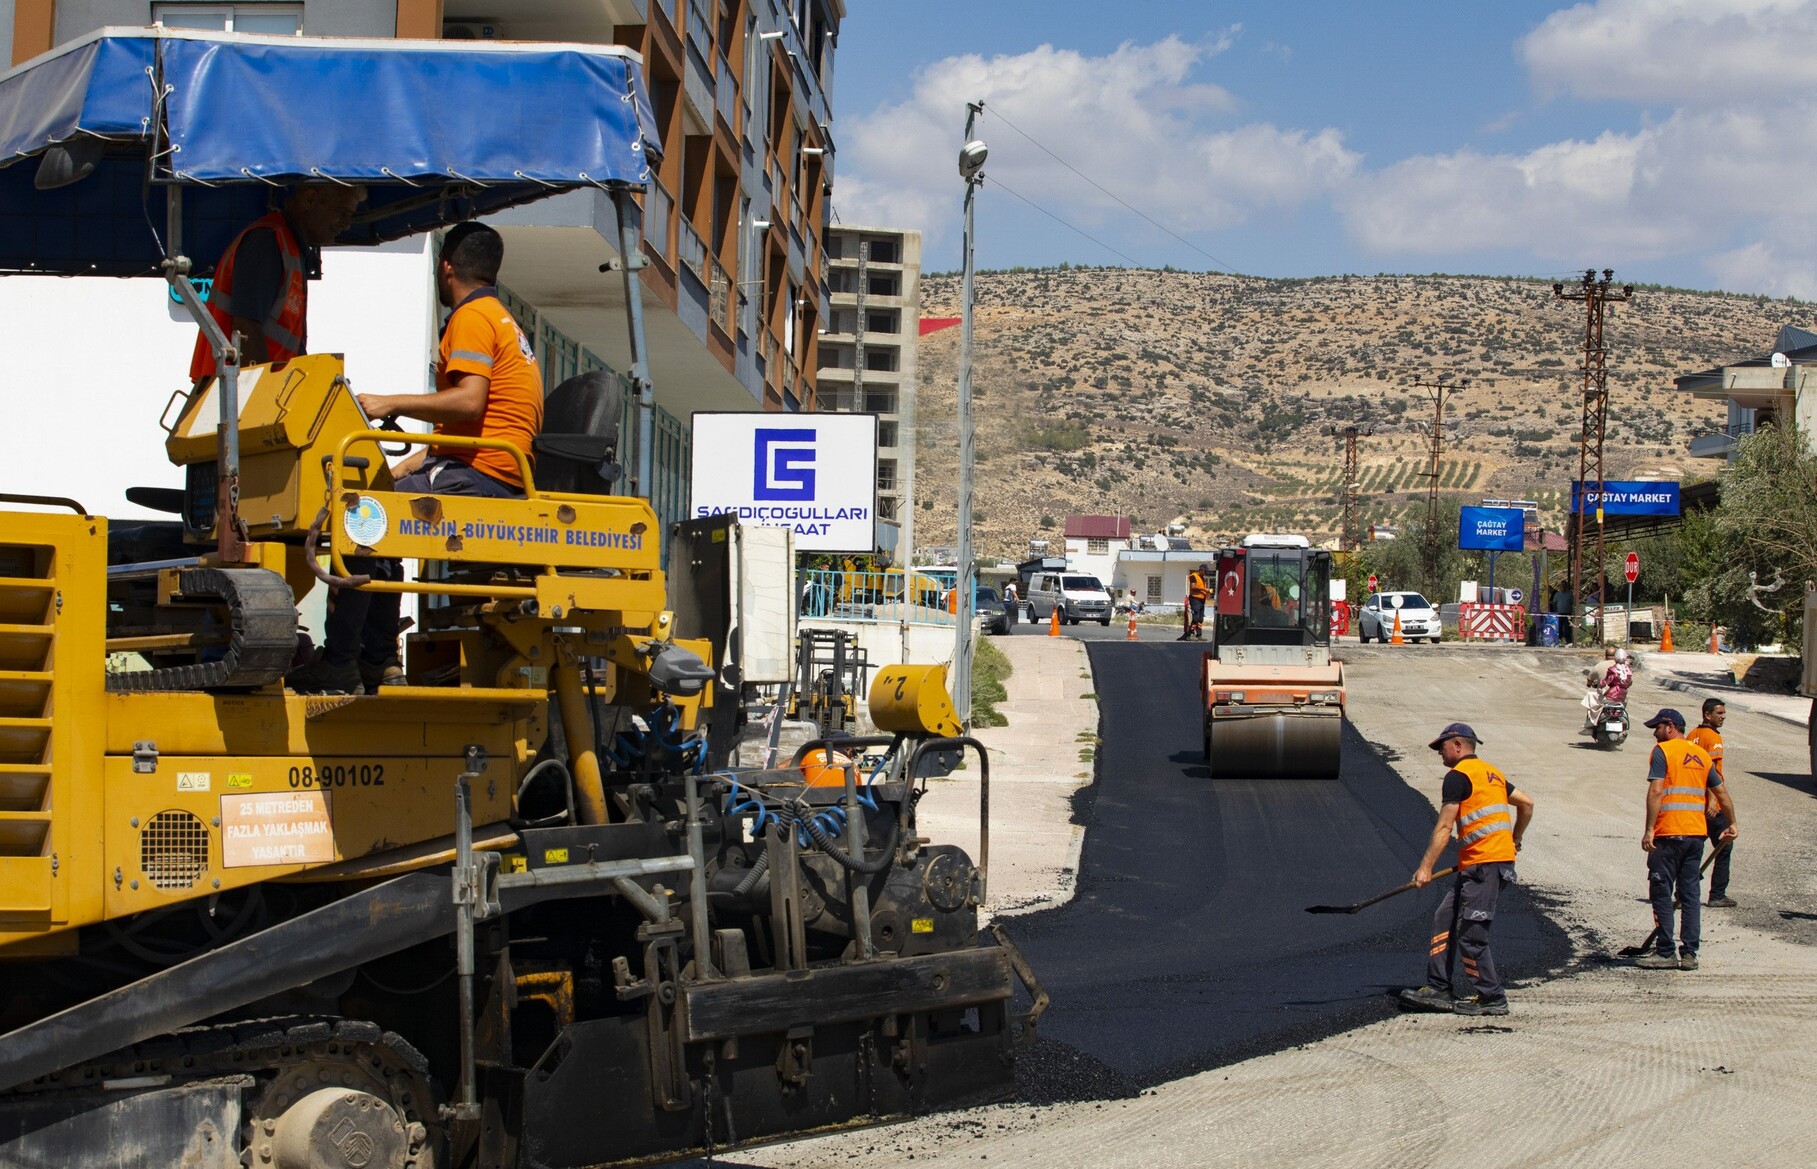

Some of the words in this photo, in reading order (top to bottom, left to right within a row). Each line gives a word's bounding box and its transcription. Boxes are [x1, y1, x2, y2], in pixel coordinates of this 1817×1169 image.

[1629, 493, 1672, 503] MARKET
[465, 518, 558, 546] BÜYÜKŞEHİR
[1477, 520, 1507, 529] ÇAĞTAY
[1476, 529, 1507, 537] MARKET
[1625, 561, 1639, 573] DUR
[289, 764, 385, 788] 08-90102
[239, 802, 253, 816] 25
[255, 799, 314, 815] METREDEN
[227, 825, 261, 839] FAZLA
[263, 821, 328, 838] YAKLAŞMAK
[251, 844, 305, 860] YASAKTIR
